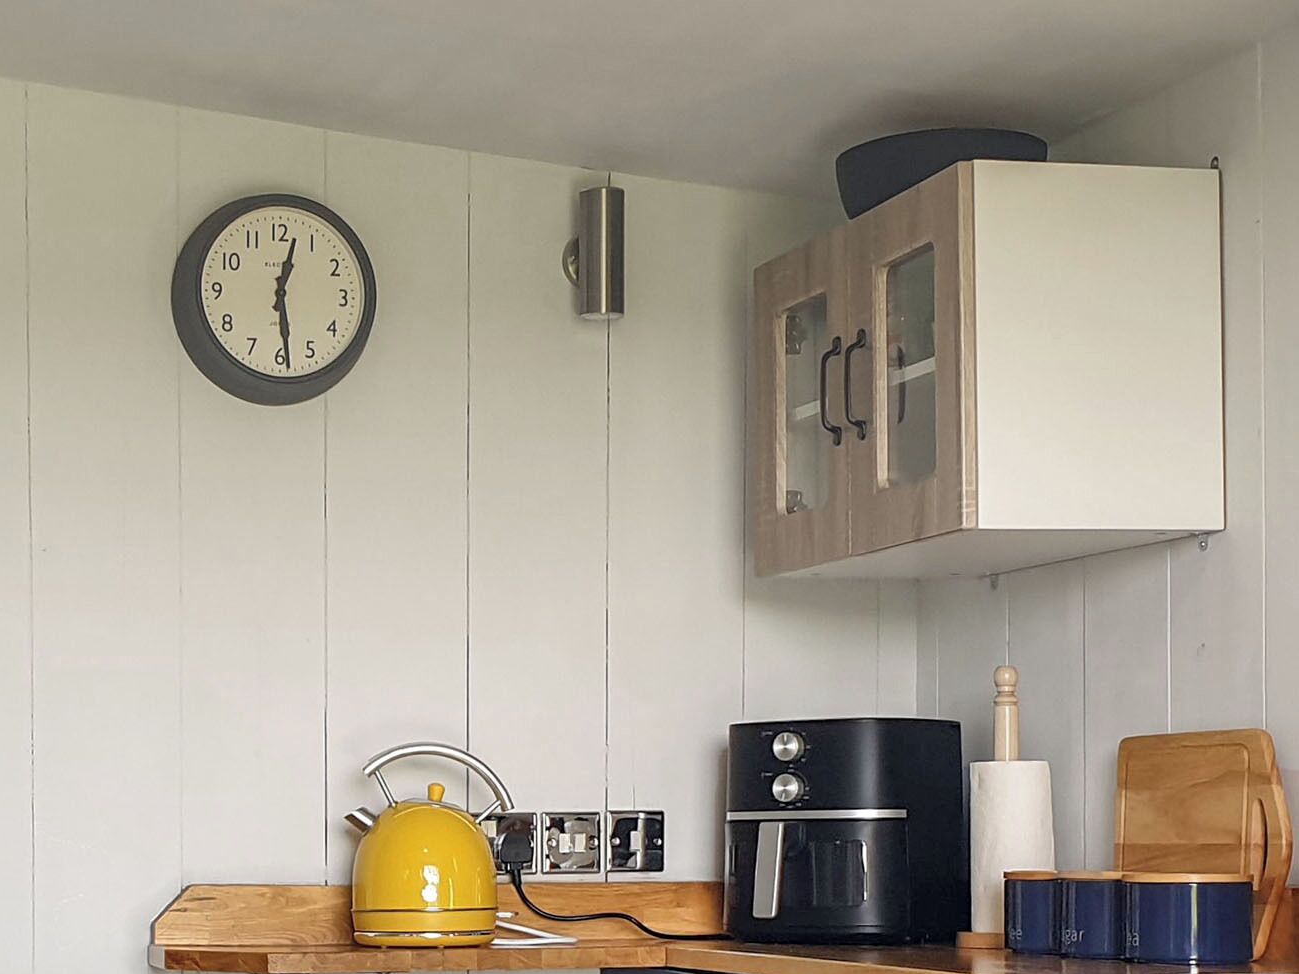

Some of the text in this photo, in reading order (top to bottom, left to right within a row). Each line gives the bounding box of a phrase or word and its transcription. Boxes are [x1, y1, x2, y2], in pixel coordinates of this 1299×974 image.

[246, 229, 259, 249] 11
[271, 223, 289, 242] 12
[222, 252, 241, 271] 10
[330, 258, 341, 277] 2
[211, 281, 223, 300] 9
[338, 288, 348, 307] 3
[221, 314, 233, 333] 8
[326, 319, 338, 338] 4
[246, 337, 258, 356] 7
[304, 340, 316, 359] 5
[274, 347, 286, 366] 6
